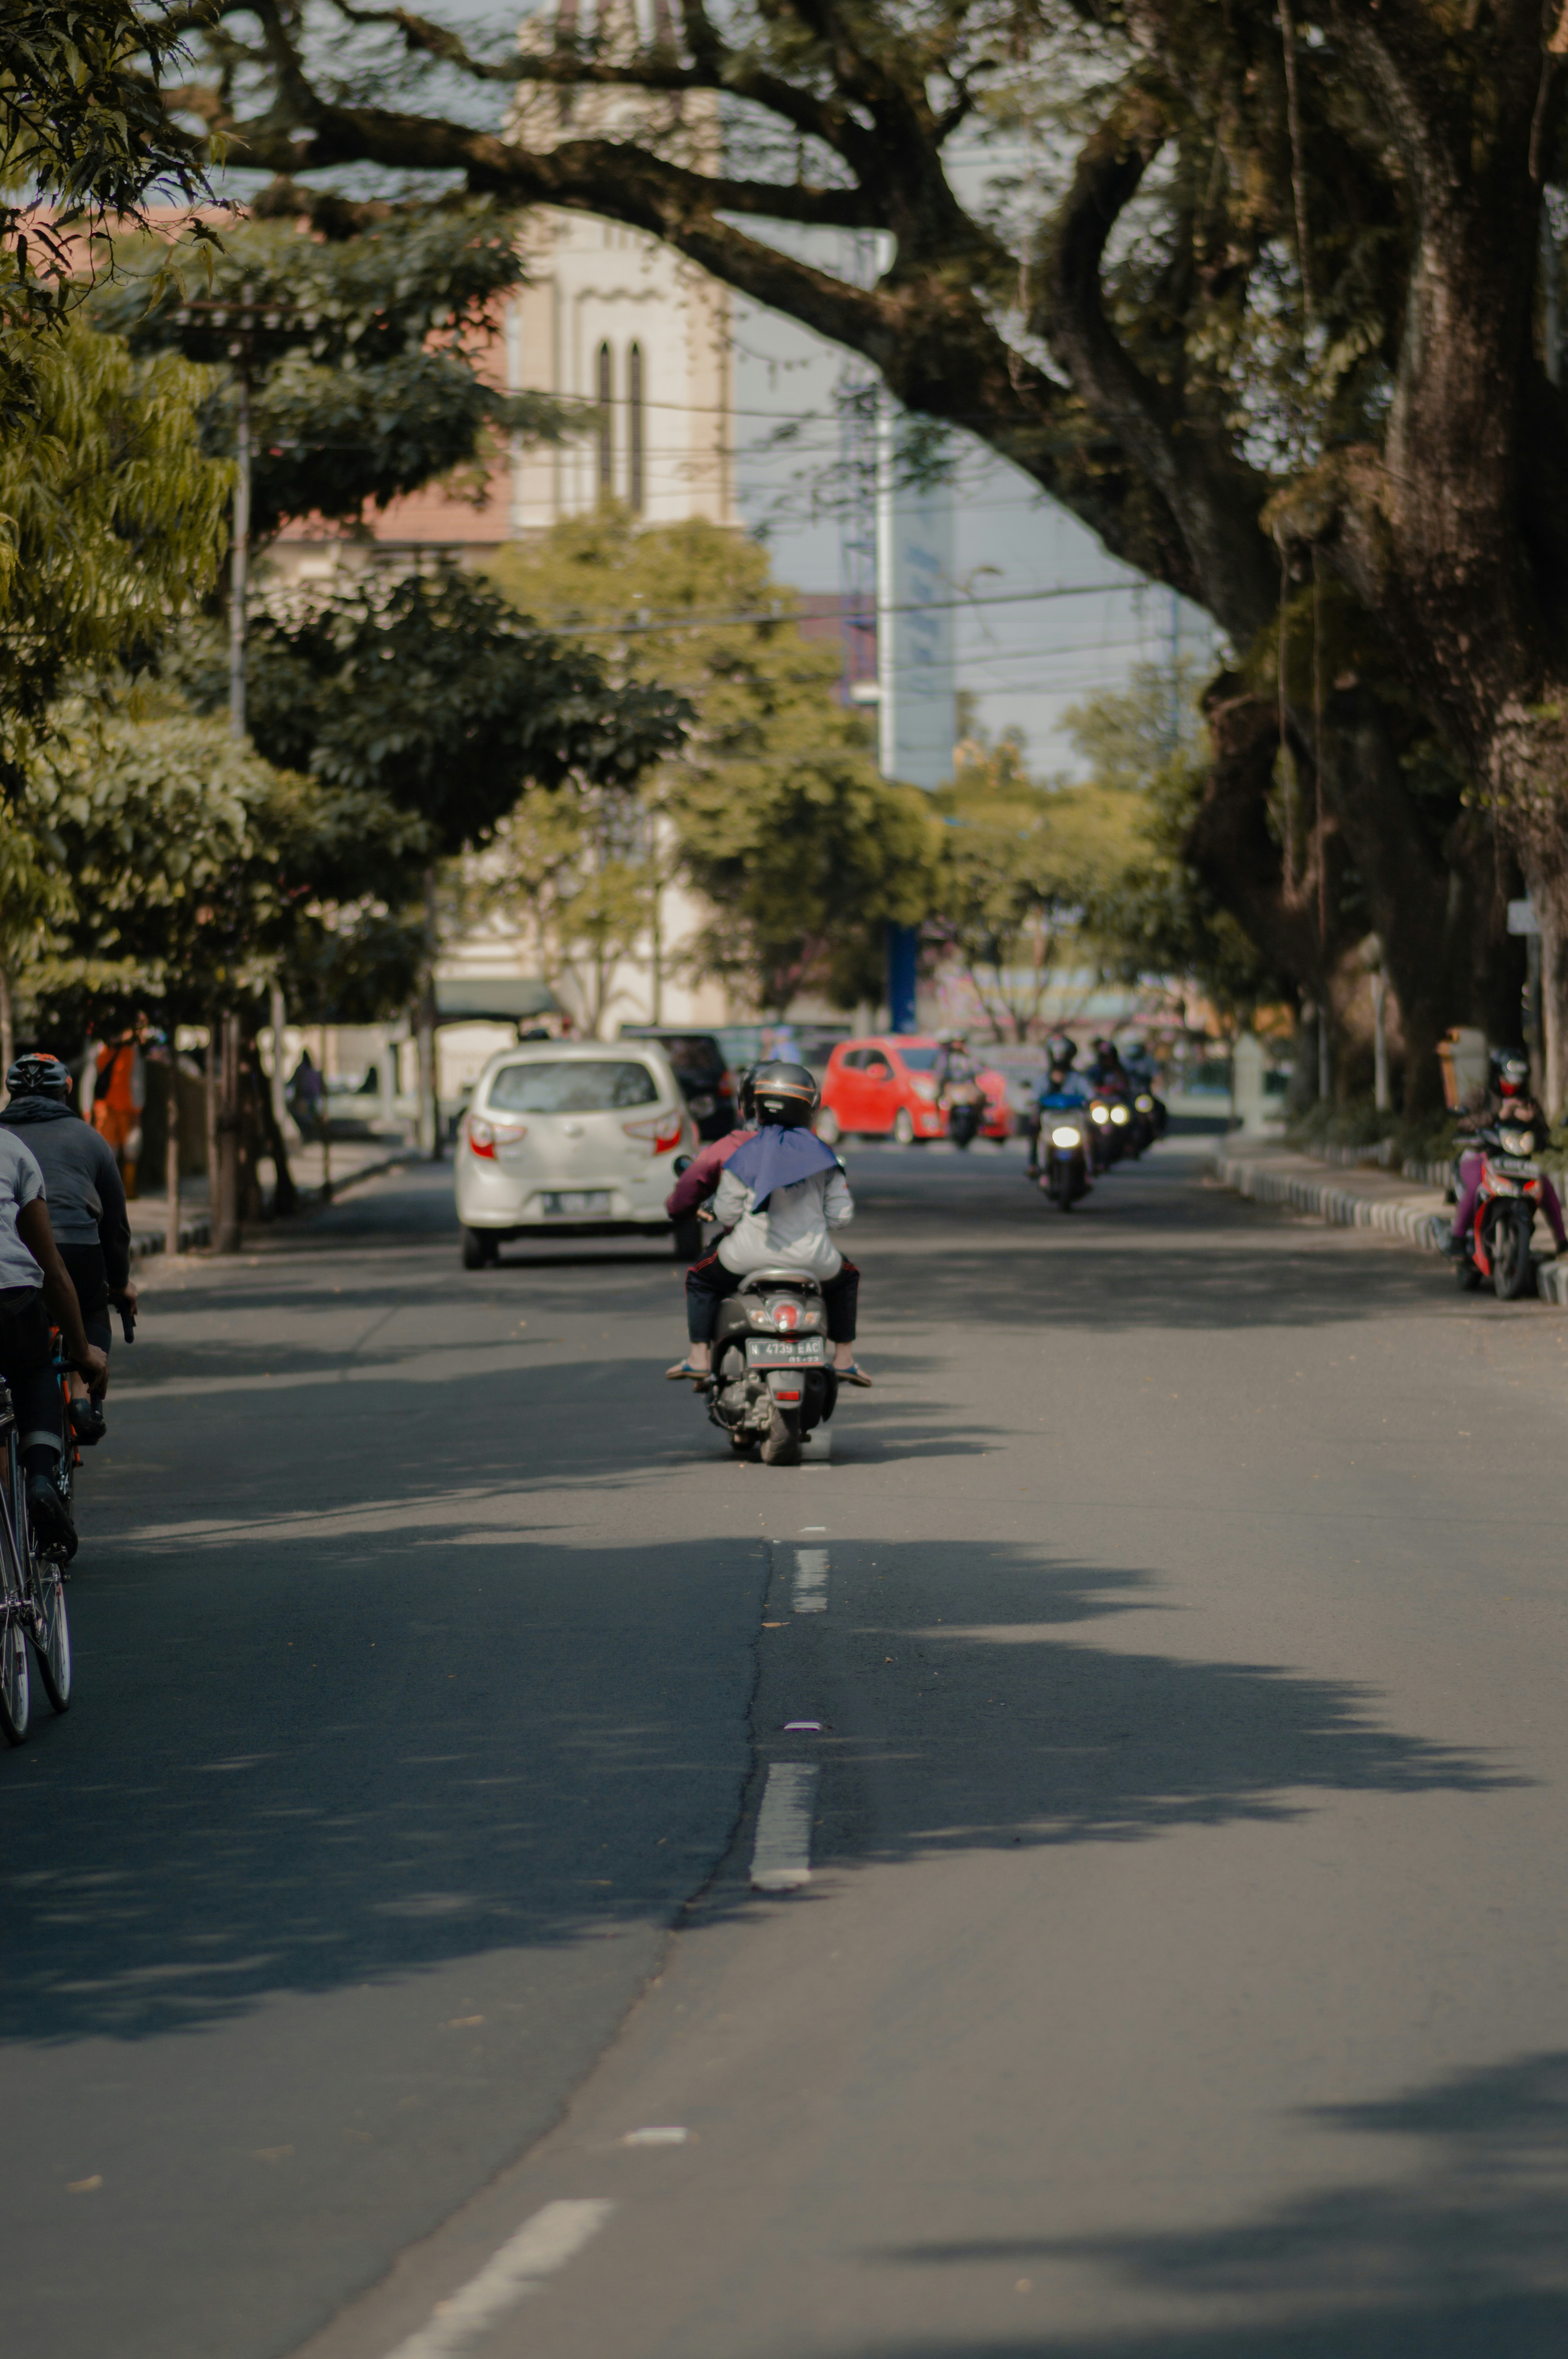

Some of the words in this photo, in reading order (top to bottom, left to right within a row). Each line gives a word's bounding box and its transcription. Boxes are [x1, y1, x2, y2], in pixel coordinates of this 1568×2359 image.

[751, 1345, 759, 1354] N
[766, 1343, 793, 1354] 4739
[798, 1343, 819, 1353] EAC
